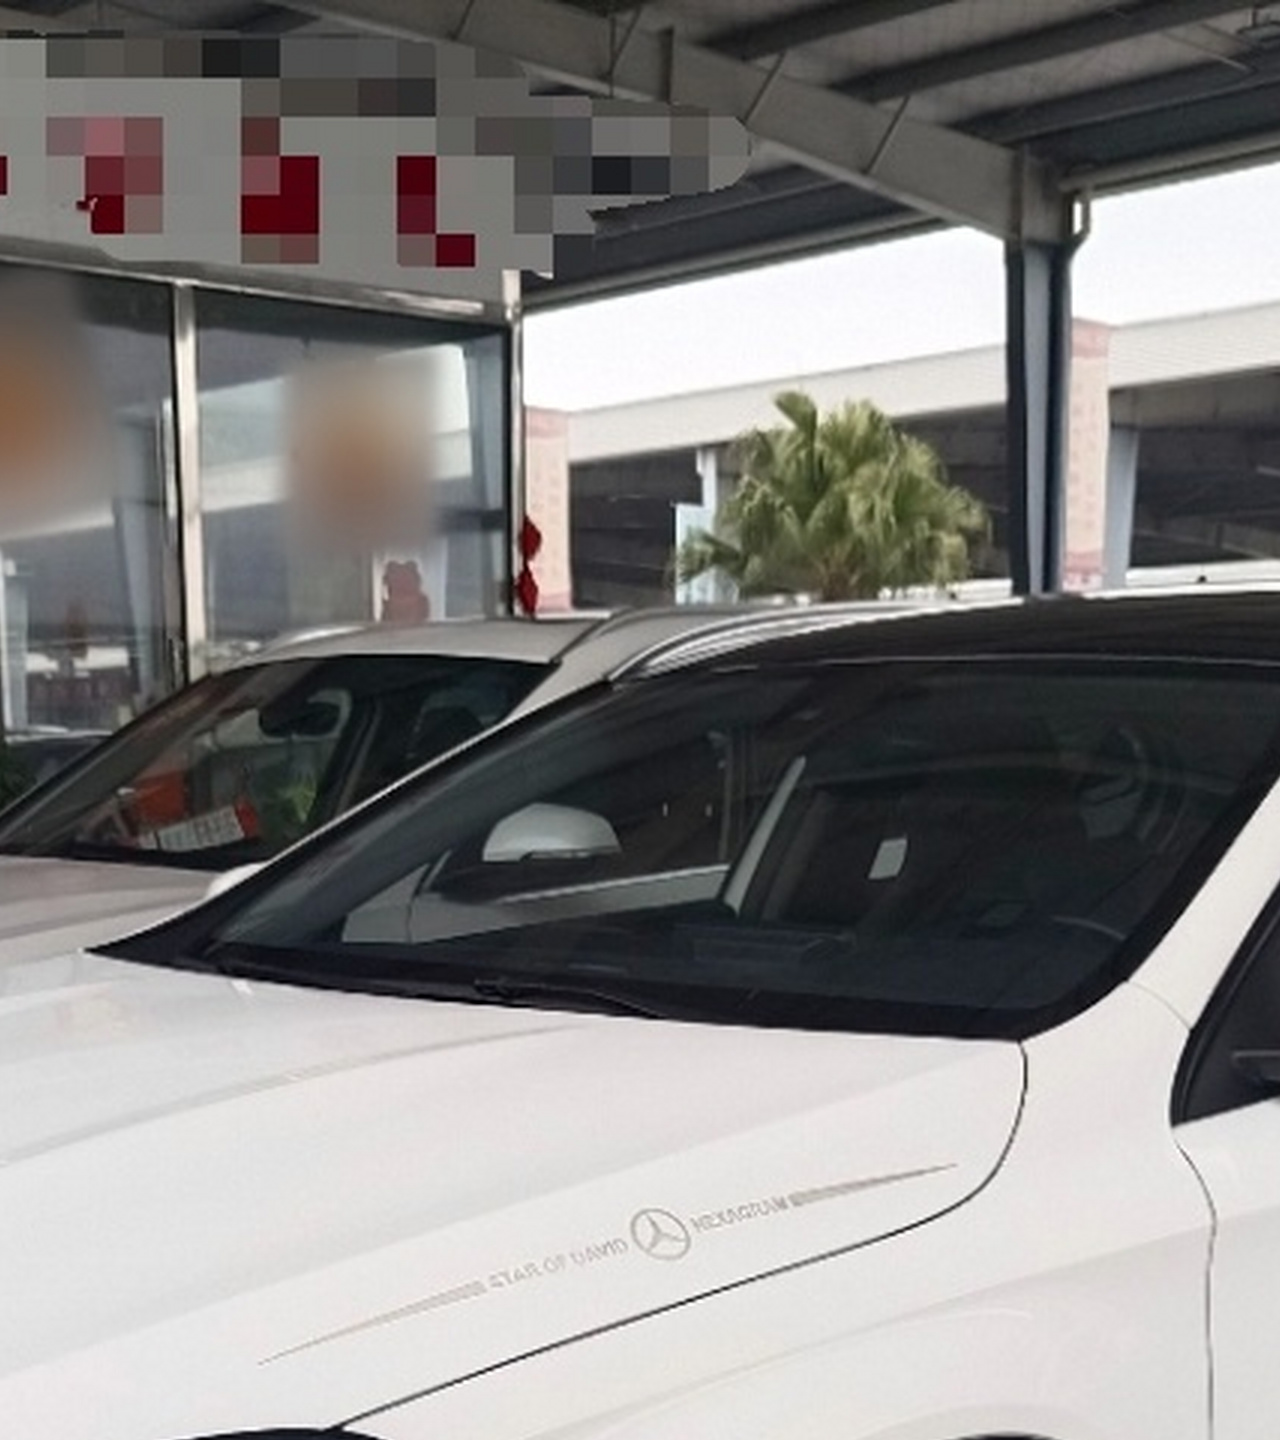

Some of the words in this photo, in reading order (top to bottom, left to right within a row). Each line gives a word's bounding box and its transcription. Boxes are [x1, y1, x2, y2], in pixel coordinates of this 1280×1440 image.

[488, 1261, 543, 1289] STAR
[543, 1253, 566, 1274] OF
[570, 1237, 629, 1266] DAVID
